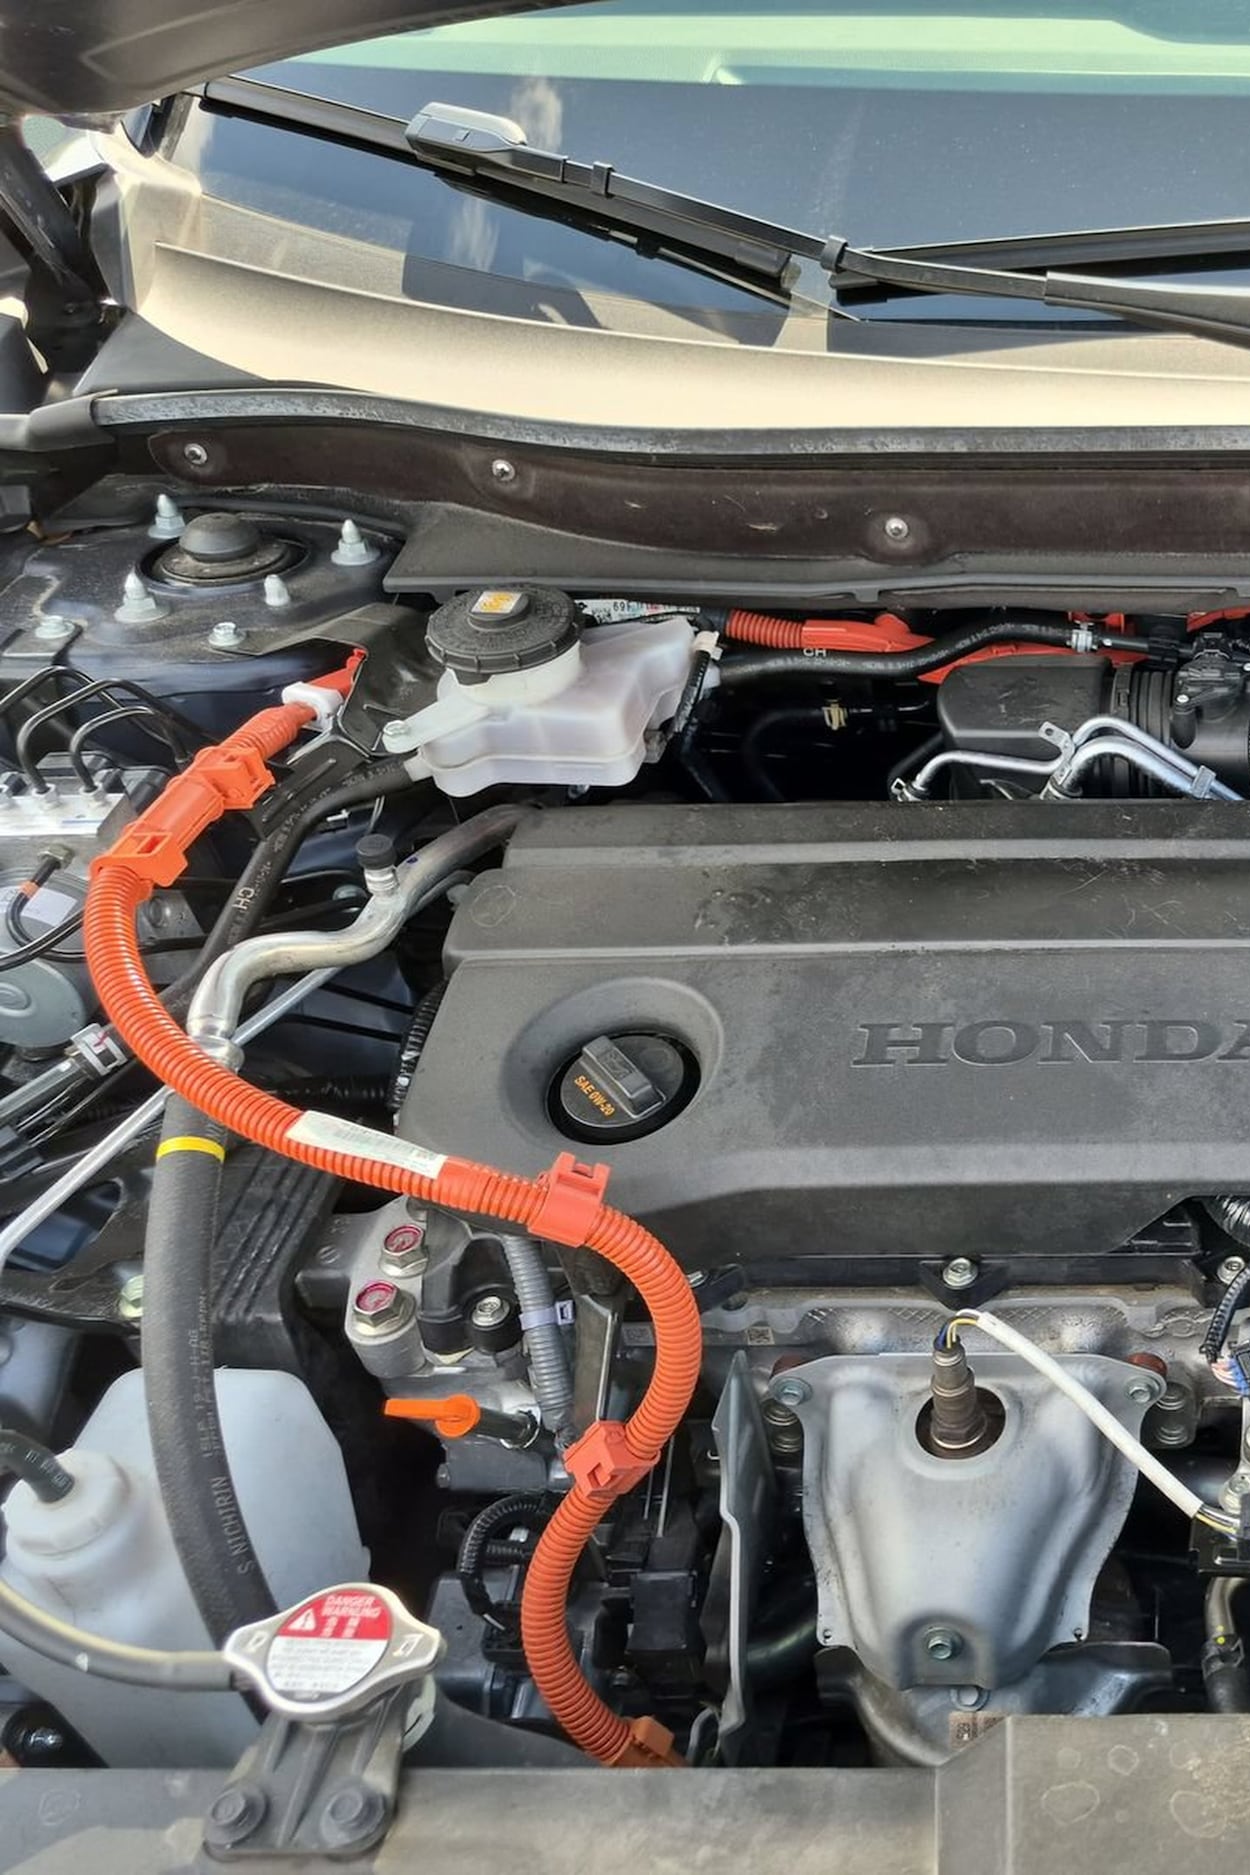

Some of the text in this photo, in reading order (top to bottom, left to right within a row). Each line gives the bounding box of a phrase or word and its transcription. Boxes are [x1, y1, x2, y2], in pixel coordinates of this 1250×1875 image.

[803, 648, 827, 658] CH
[232, 887, 255, 911] CH
[575, 1076, 616, 1116] SAE 0W-20
[211, 1476, 257, 1575] S NICHIRIN
